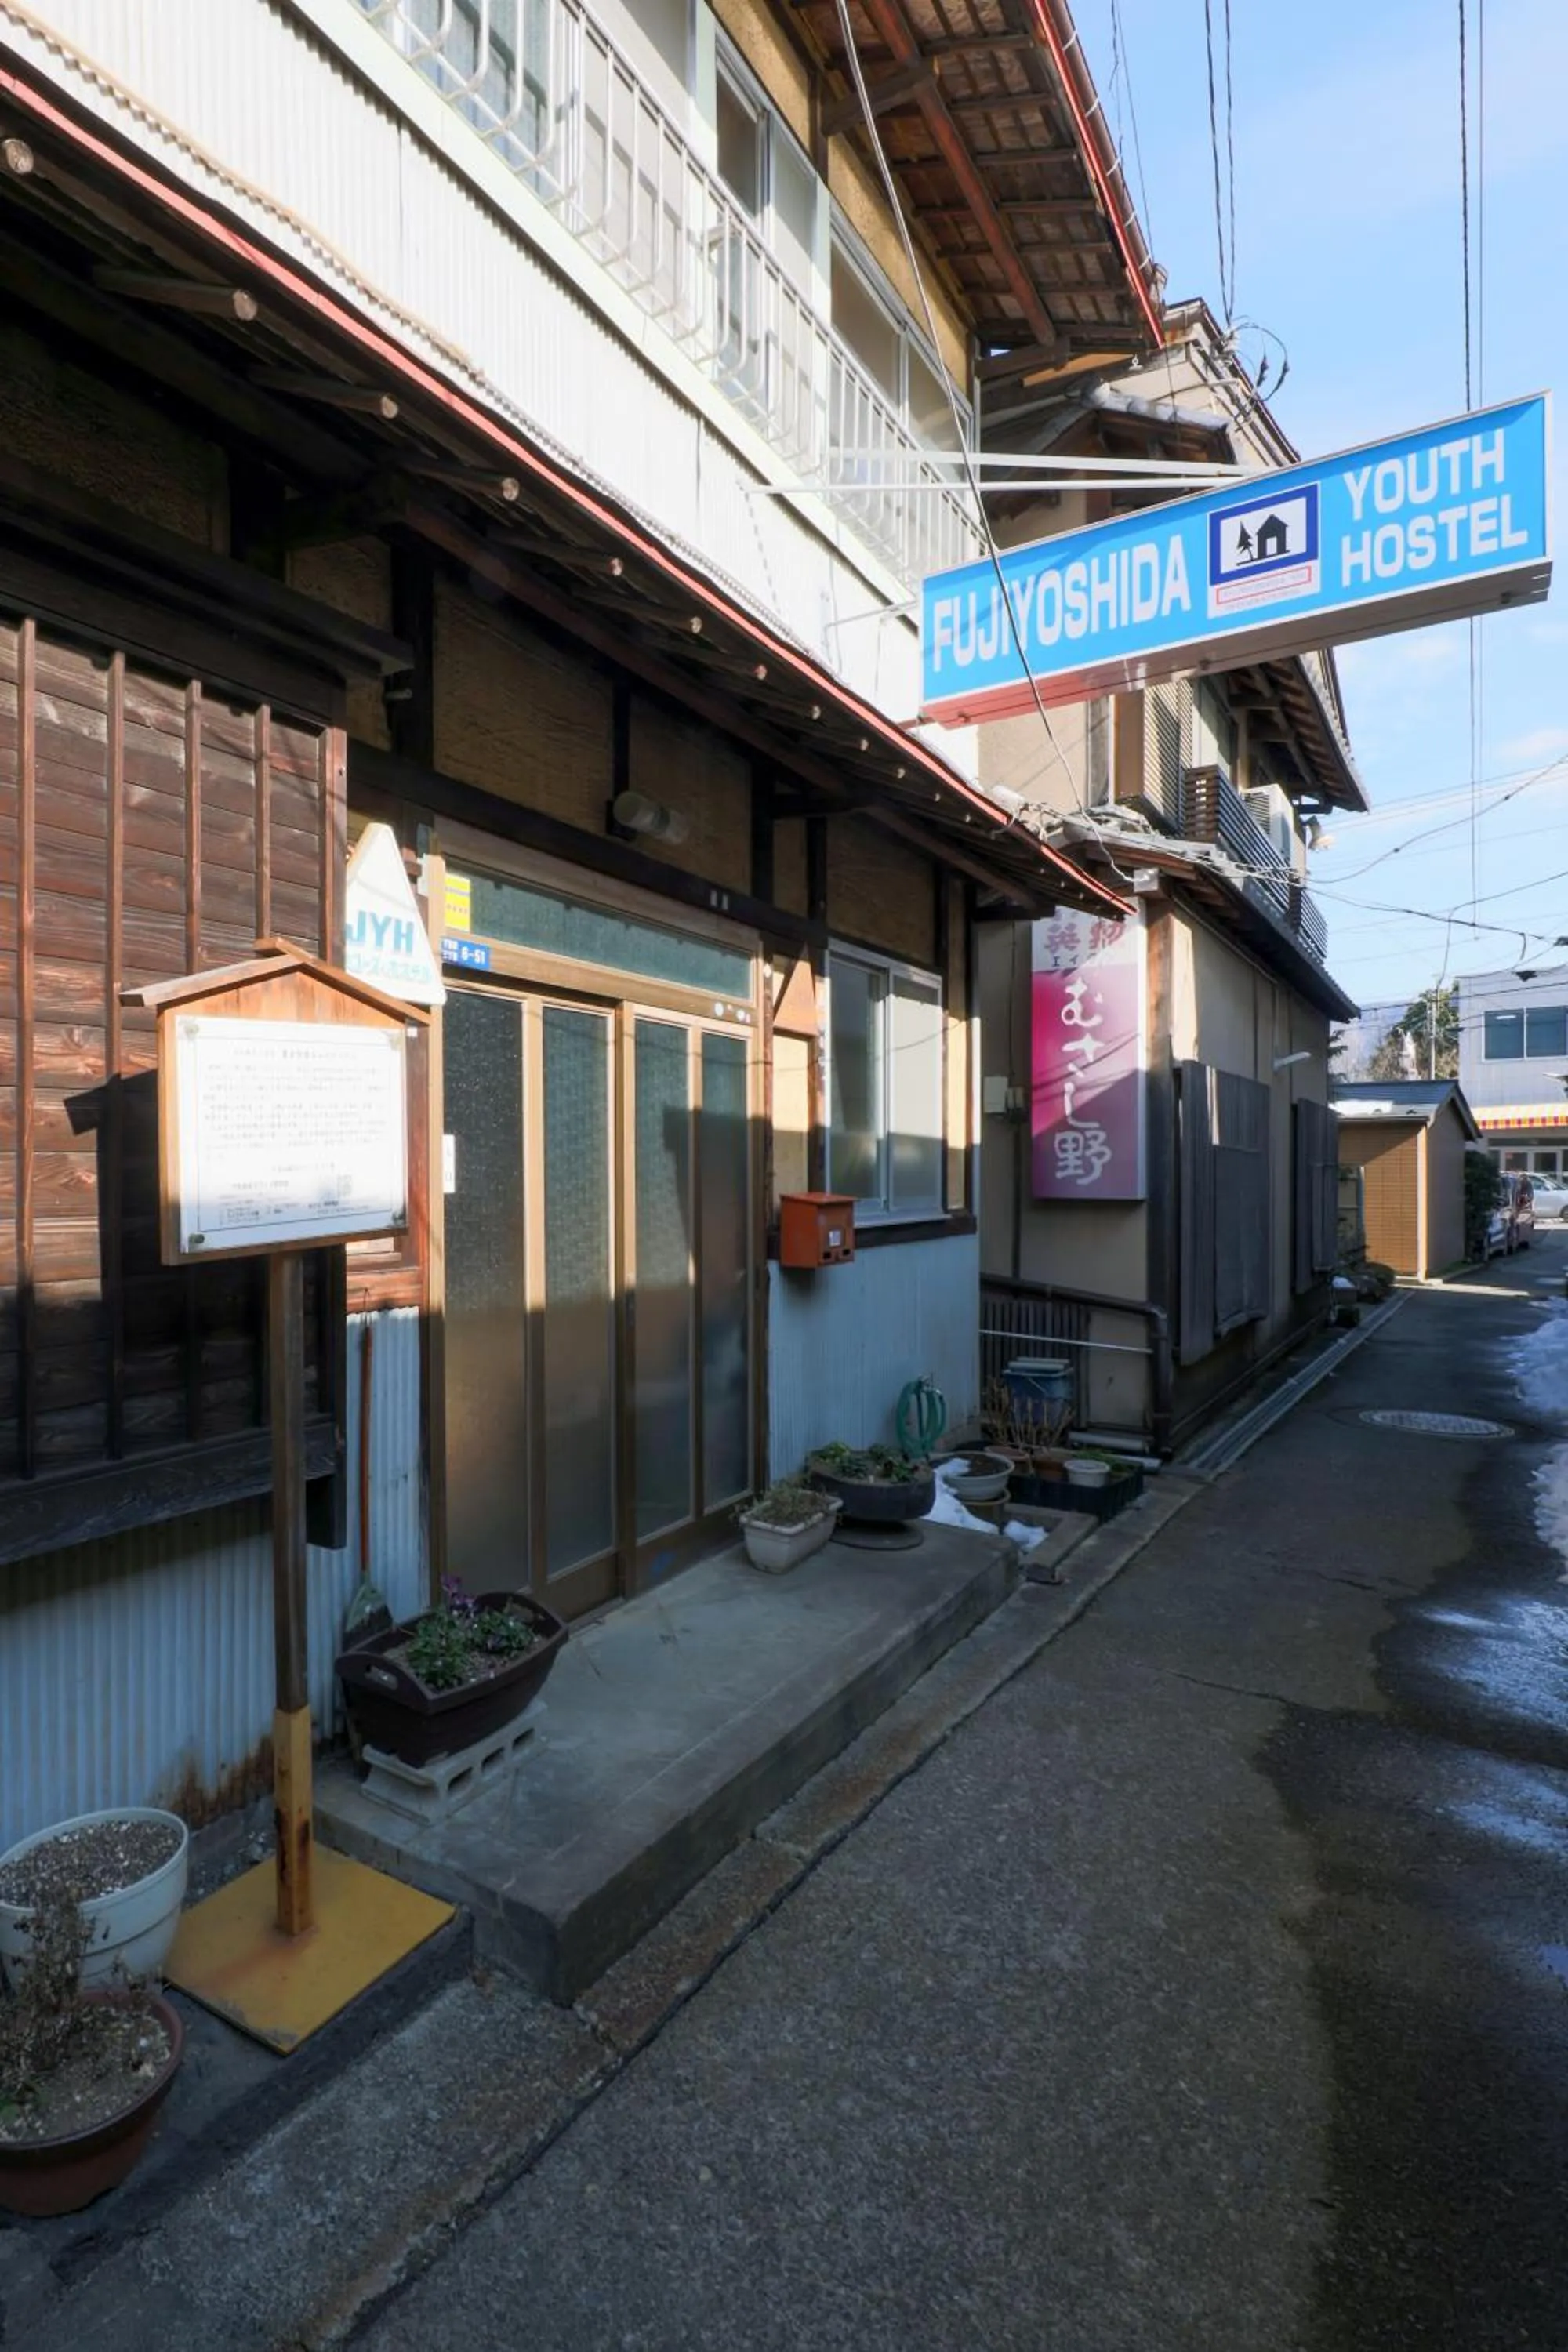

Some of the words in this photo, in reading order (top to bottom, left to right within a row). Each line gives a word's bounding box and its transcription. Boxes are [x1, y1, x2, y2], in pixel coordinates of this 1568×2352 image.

[1343, 428, 1504, 521] YOUTH
[1341, 494, 1528, 587] HOSTEL
[933, 535, 1191, 672] FUJIYOSHIDA
[346, 910, 414, 955] JYH
[1054, 977, 1112, 1185] むさし野
